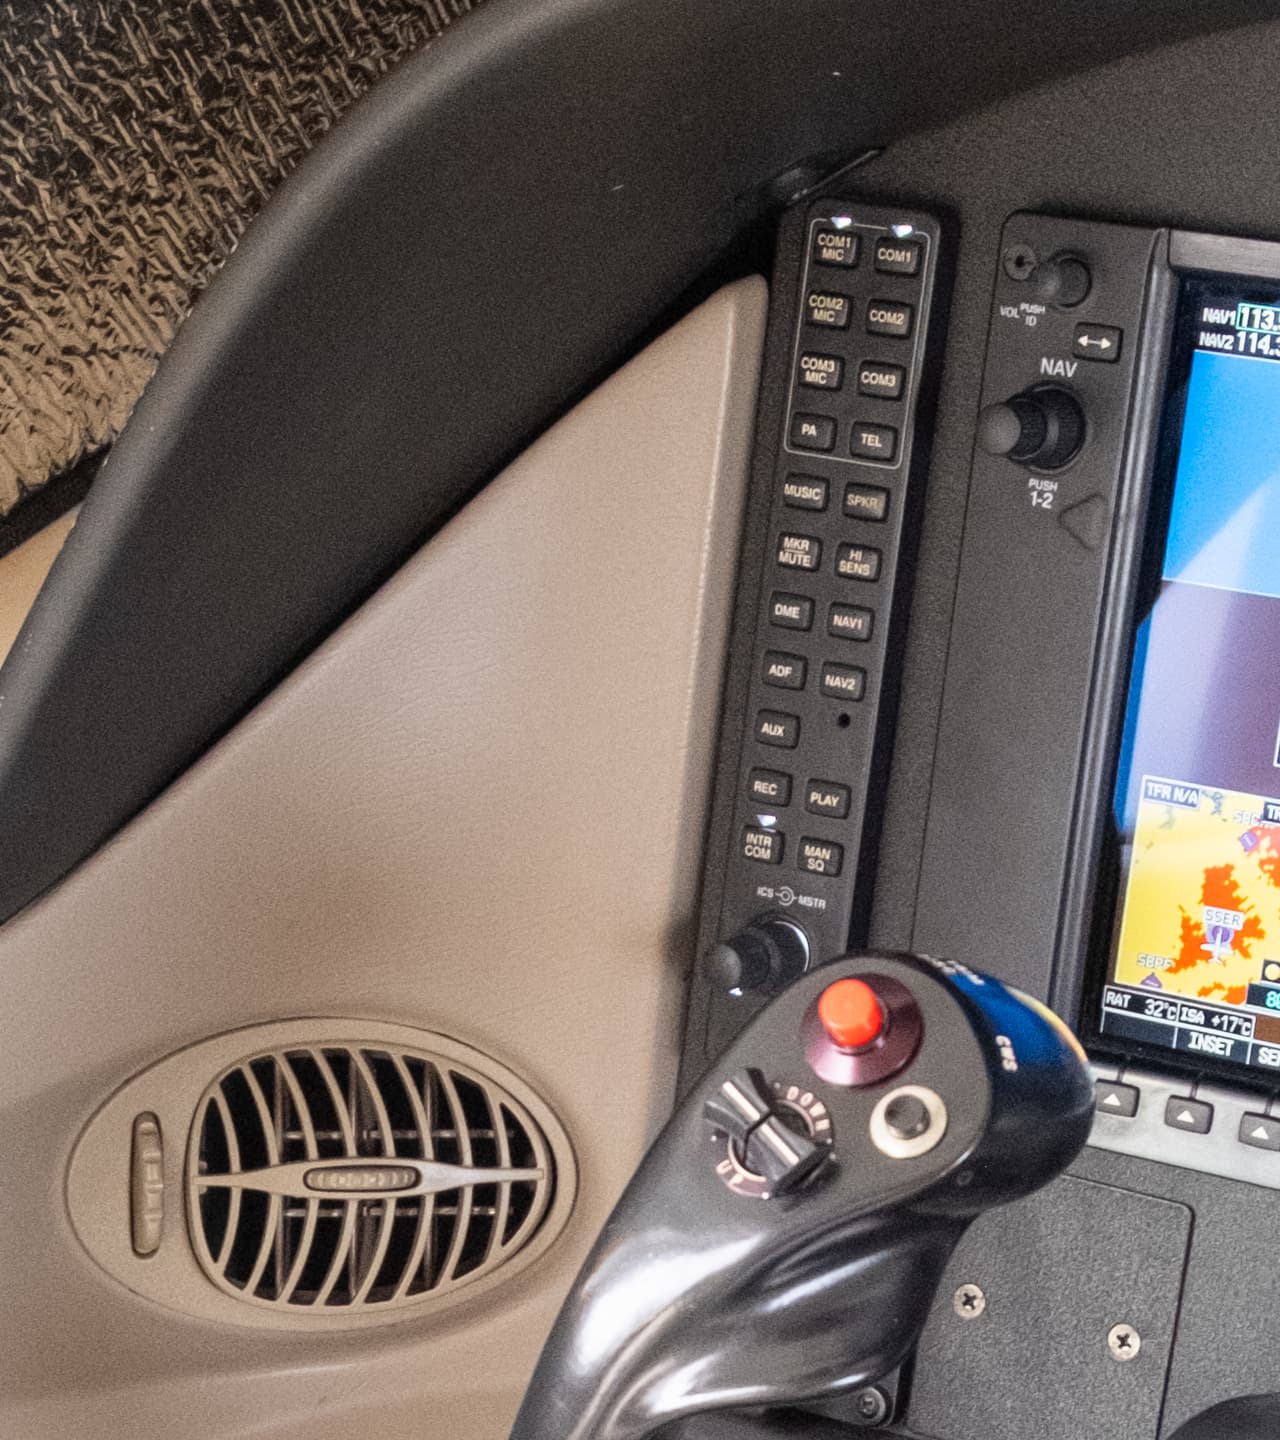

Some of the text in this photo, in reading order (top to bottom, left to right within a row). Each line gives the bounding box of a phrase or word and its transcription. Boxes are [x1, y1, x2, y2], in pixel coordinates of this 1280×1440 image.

[877, 246, 911, 264] COM1
[869, 307, 905, 326] COM2
[1202, 307, 1237, 326] NAV1
[1199, 332, 1235, 350] NAV2
[1040, 358, 1077, 378] NAV
[861, 370, 896, 387] COM3
[801, 423, 817, 437] PA
[861, 432, 883, 448] TEL
[784, 483, 821, 501] MUSIC
[1028, 477, 1058, 491] PUSH
[1030, 491, 1053, 509] 1-2
[784, 536, 810, 551] MKR
[779, 550, 811, 567] MUTE
[774, 603, 800, 619] DME
[833, 614, 863, 630] NAV1
[769, 664, 793, 678] ADF
[825, 674, 856, 690] NAV2
[761, 723, 784, 737] AUX
[753, 780, 778, 796] REC
[1146, 783, 1200, 807] TFR N/A
[809, 792, 840, 809] PLAY
[804, 845, 831, 860] MAN
[807, 859, 825, 872] SQ
[1187, 1032, 1234, 1057] INSET
